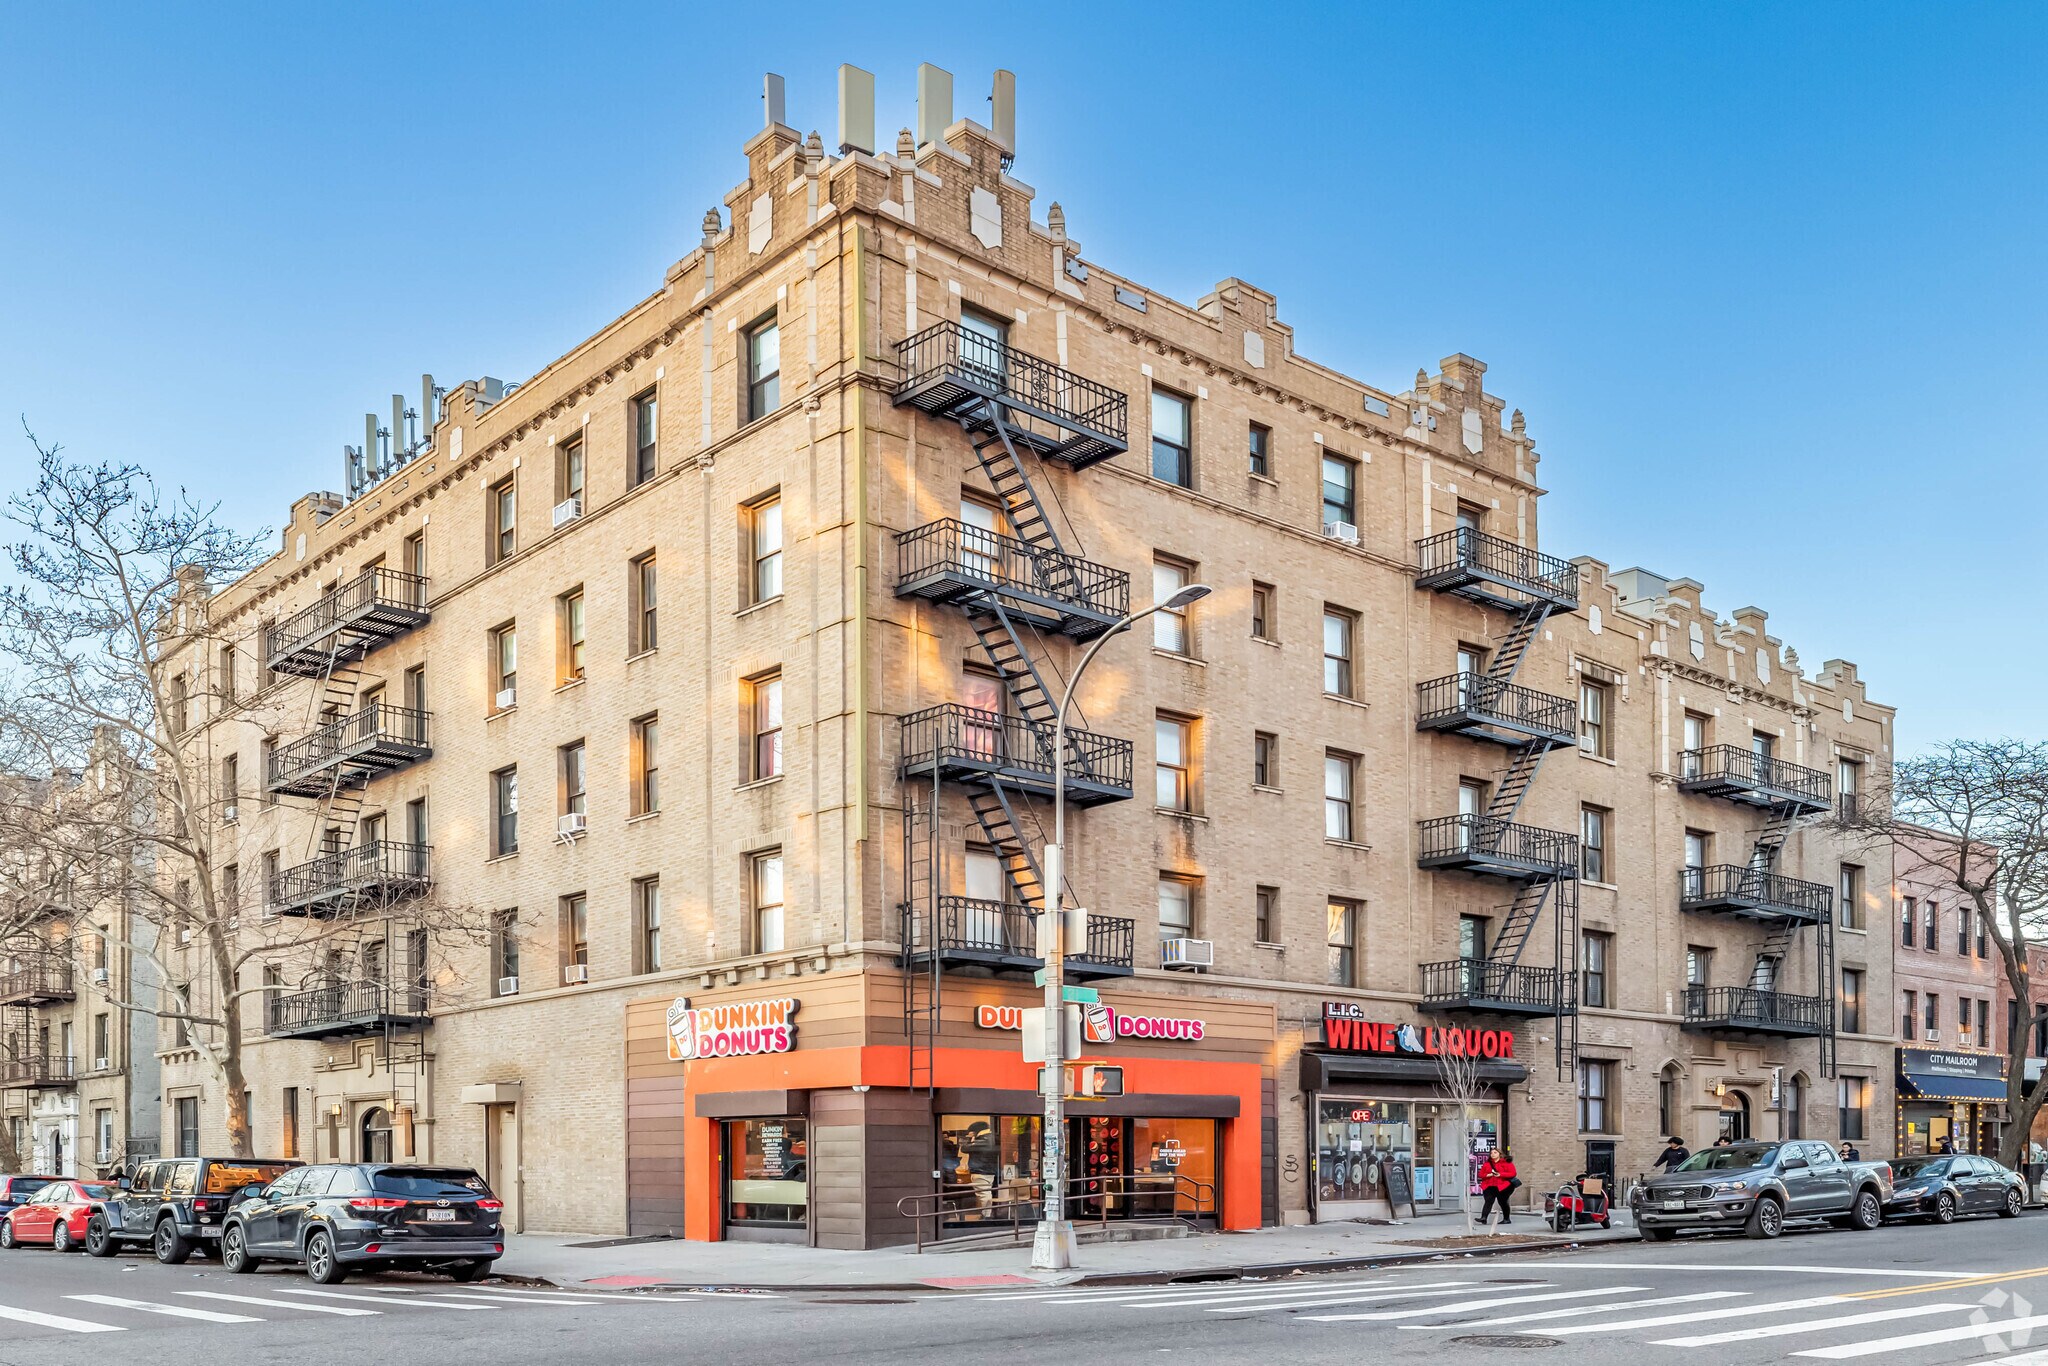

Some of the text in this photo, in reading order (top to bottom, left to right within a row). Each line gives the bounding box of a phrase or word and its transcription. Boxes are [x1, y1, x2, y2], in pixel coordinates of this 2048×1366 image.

[699, 1000, 791, 1031] DUNKIN'
[1328, 1003, 1363, 1017] L.I.C.
[1120, 1017, 1203, 1039] DONUTS
[699, 1026, 788, 1056] DONUTS
[1326, 1019, 1514, 1058] WINE LIQUOR
[1930, 1054, 1977, 1066] CITY MAILROOM
[1352, 1110, 1371, 1121] OPE
[1006, 1167, 1013, 1175] A
